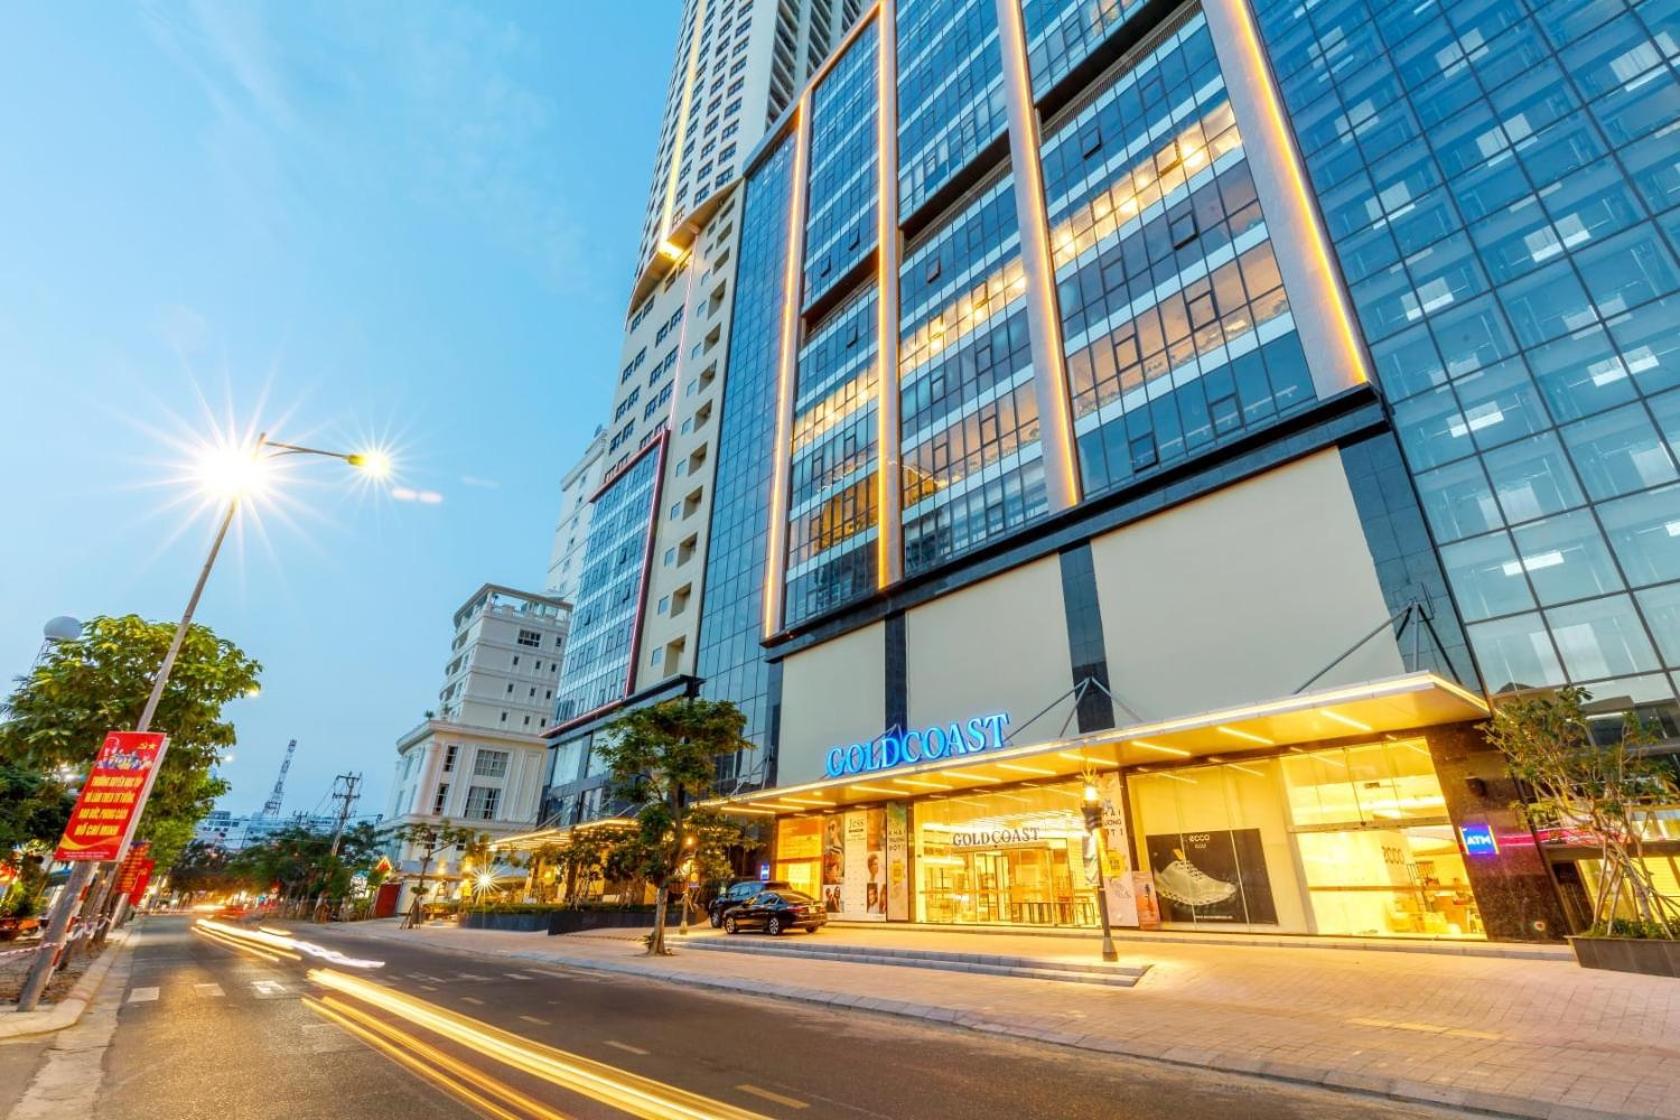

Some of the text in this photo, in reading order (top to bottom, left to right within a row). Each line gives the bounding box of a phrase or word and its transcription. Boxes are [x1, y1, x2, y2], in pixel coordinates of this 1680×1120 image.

[826, 713, 1010, 777] GOLDCOAST
[952, 826, 1041, 847] GOLDCOAST
[1467, 834, 1492, 846] ATM
